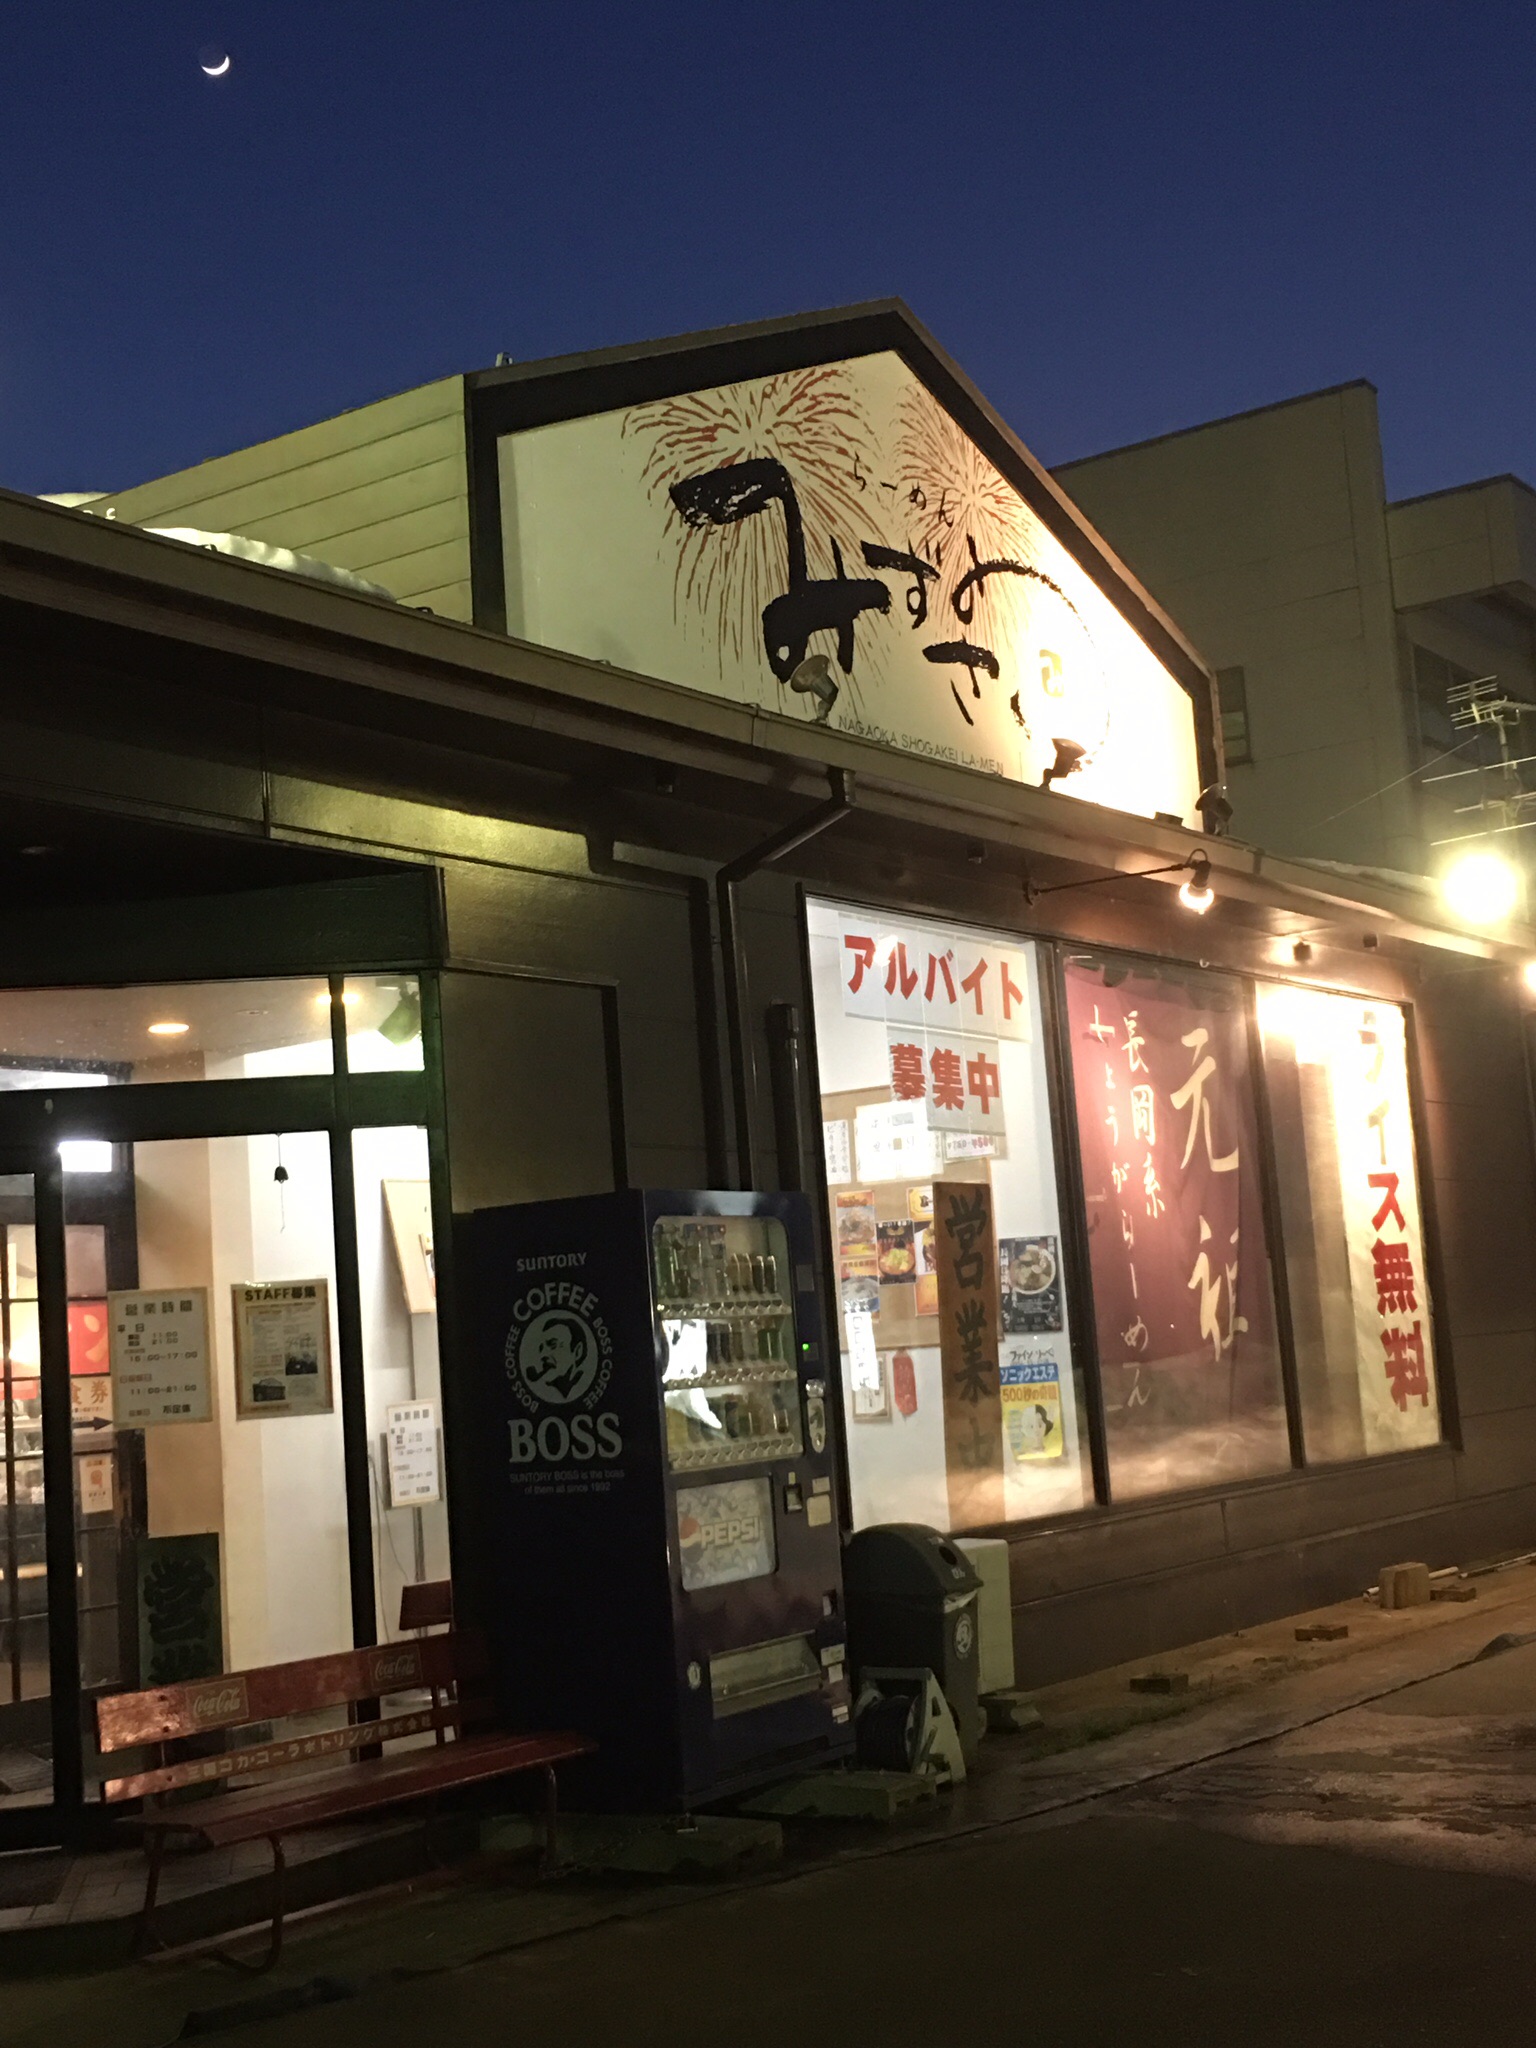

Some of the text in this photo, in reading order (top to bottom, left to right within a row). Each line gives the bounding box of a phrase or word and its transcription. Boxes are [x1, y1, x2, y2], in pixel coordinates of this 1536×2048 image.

[853, 450, 953, 528] らーめん
[838, 715, 1004, 776] NAGAOKA SHOGAKEI LA-MEN
[844, 933, 1023, 1020] アルバイト
[889, 1041, 1000, 1115] 募集中
[1357, 1010, 1429, 1412] ライス無料
[516, 1252, 587, 1272] SUNTORY
[513, 1282, 599, 1321] COFFEE
[505, 1324, 539, 1413] BOSS COFFEE
[582, 1317, 613, 1410] BOSS COFFEE
[1000, 1365, 1055, 1383] ソニックエステ
[507, 1412, 623, 1463] BOSS
[700, 1515, 761, 1550] PEPSI
